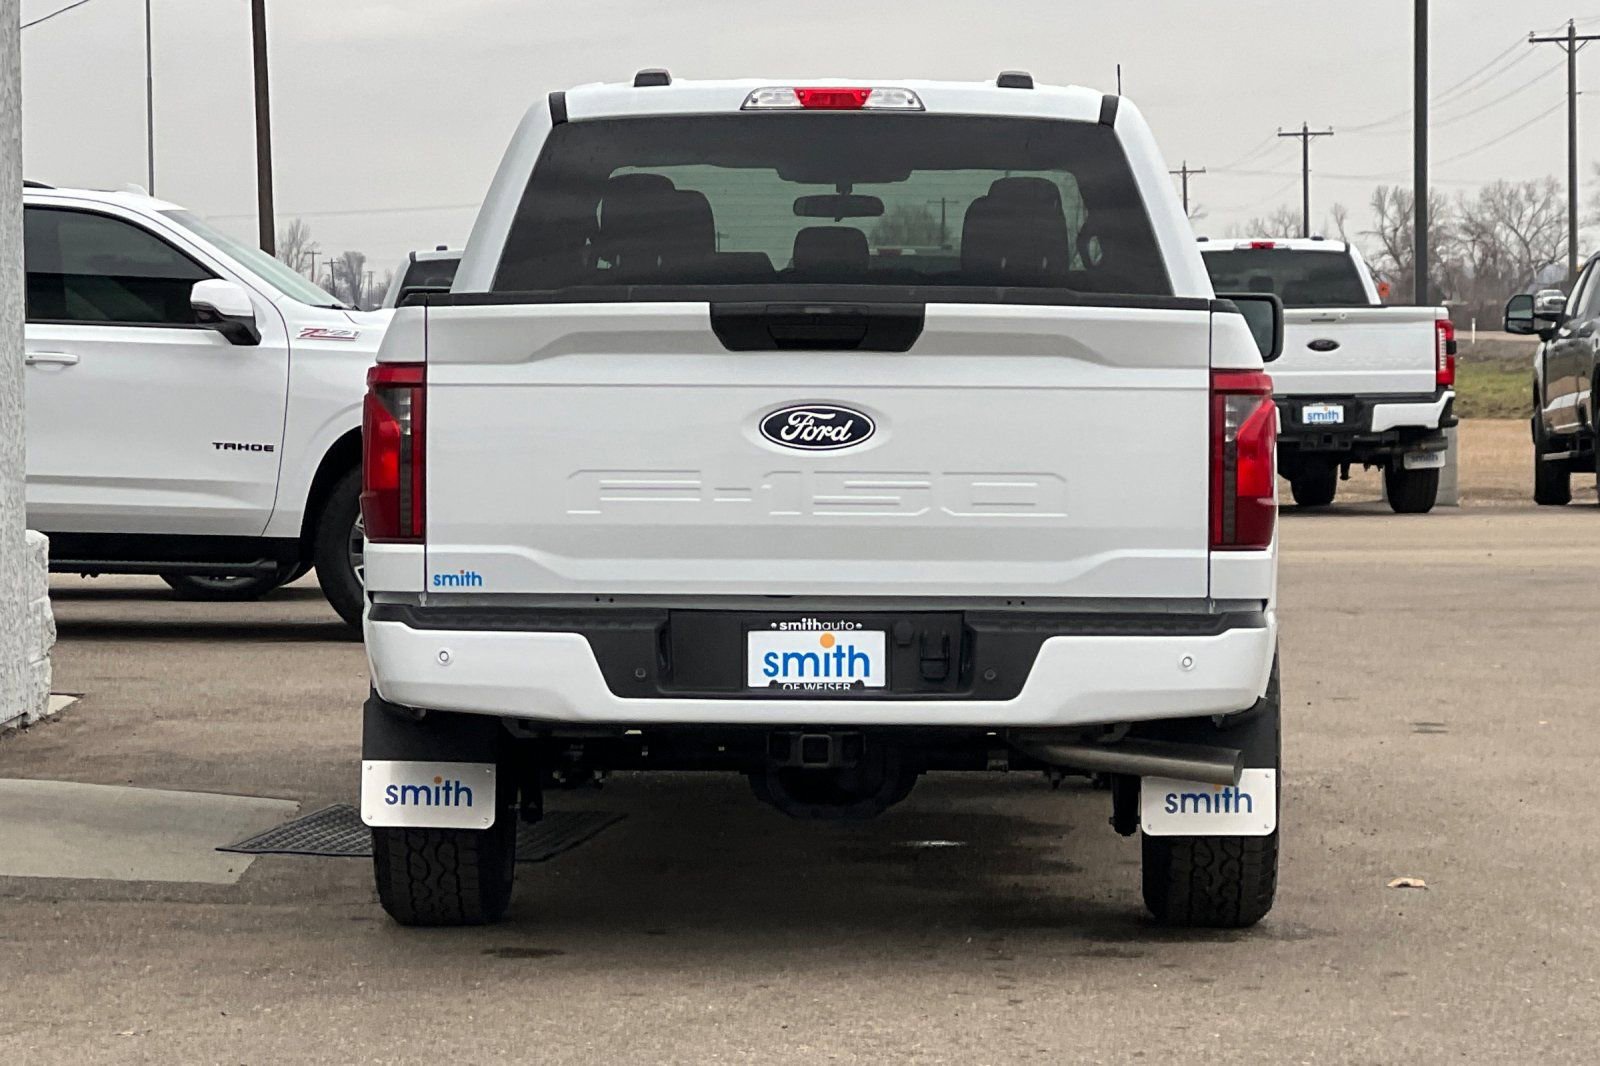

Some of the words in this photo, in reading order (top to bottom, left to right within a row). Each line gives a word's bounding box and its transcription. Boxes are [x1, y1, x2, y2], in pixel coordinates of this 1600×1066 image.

[1307, 407, 1339, 421] smith
[780, 411, 854, 442] Ford
[212, 442, 275, 452] TAHOE
[433, 569, 483, 587] smith
[763, 632, 871, 678] smith
[782, 682, 800, 690] OF
[803, 682, 851, 690] WEISER
[384, 775, 473, 807] smith
[1164, 783, 1253, 814] smith
